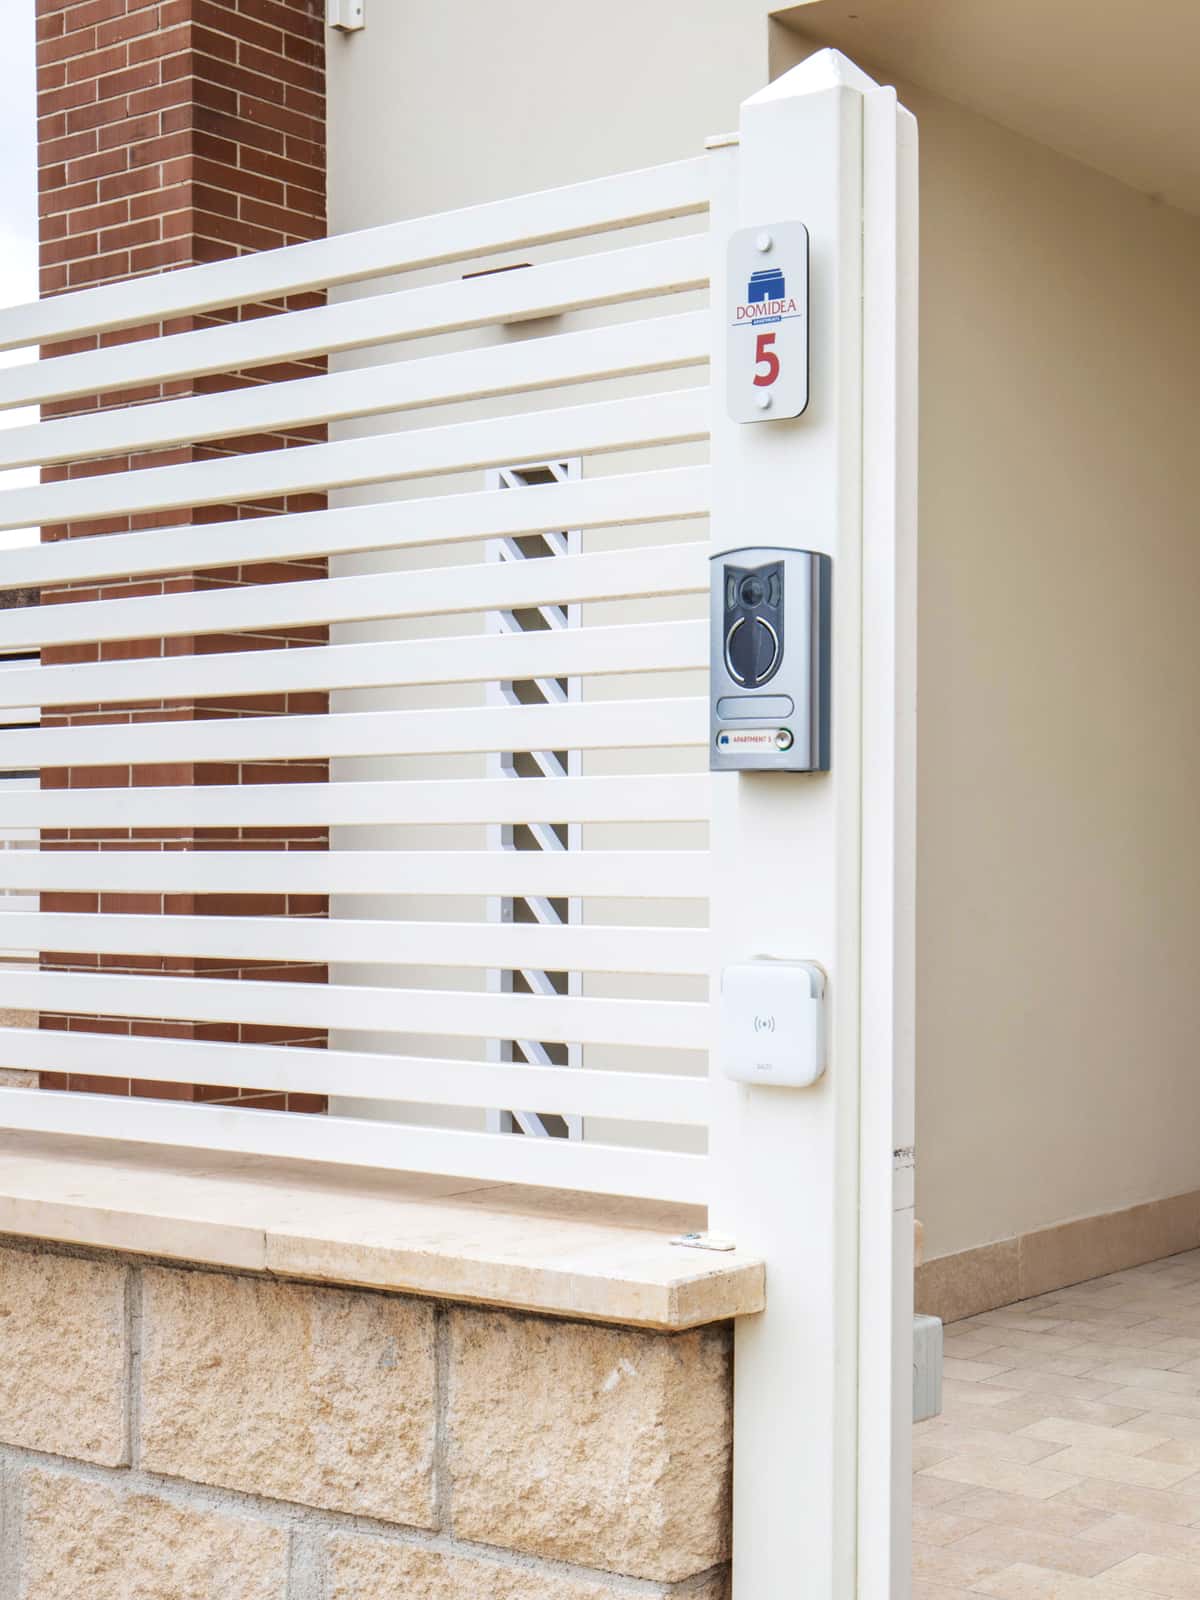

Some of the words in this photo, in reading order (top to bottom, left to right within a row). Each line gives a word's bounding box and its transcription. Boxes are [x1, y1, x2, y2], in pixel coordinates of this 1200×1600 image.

[736, 299, 797, 320] DOMIDEA
[753, 332, 780, 387] 5
[733, 735, 767, 743] APARTMENT
